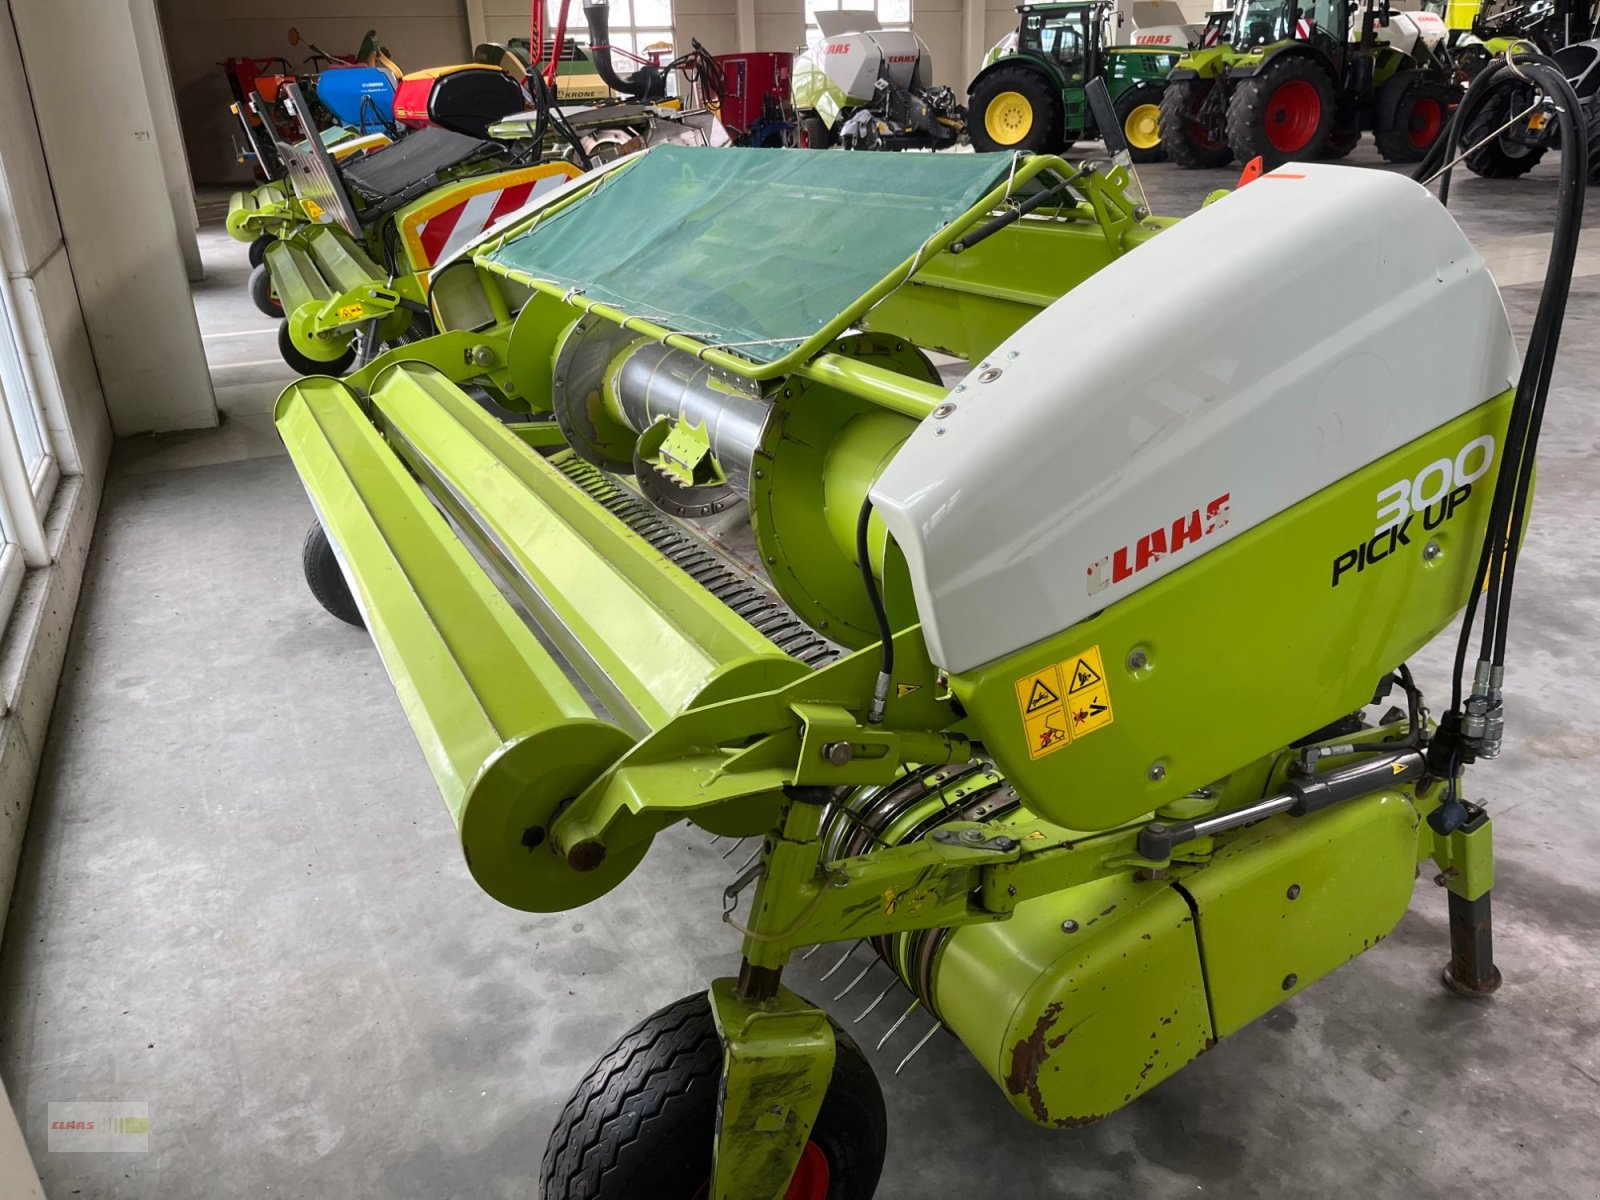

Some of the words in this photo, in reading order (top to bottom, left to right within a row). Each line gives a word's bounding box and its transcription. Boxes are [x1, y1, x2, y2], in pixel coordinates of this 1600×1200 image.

[888, 55, 916, 63] CLAAS
[1136, 34, 1172, 45] CLAAS
[1375, 435, 1494, 535] 300
[1332, 515, 1415, 587] PICK
[1422, 483, 1472, 530] UP
